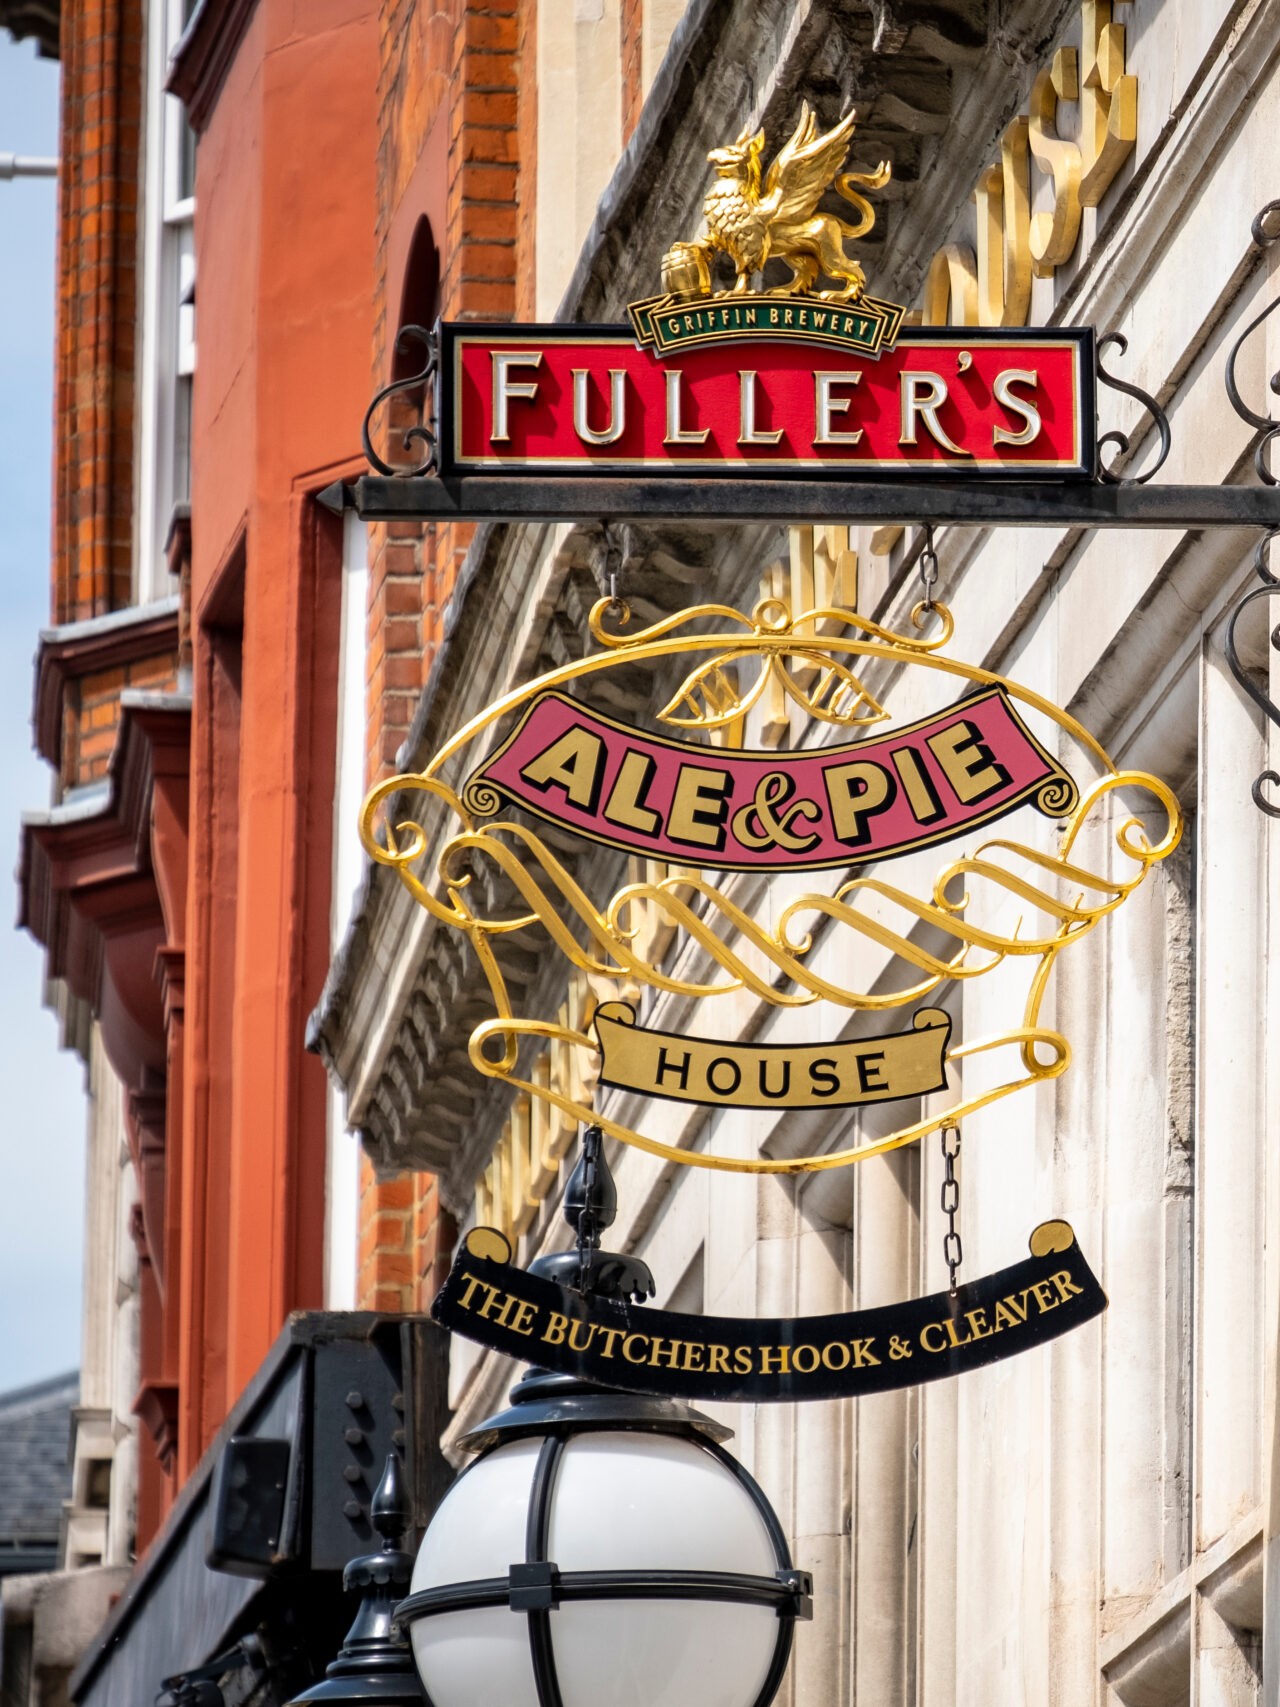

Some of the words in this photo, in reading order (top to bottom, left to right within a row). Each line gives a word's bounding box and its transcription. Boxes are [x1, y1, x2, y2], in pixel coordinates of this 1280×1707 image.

[668, 308, 756, 335] GRIFFIN
[769, 308, 870, 337] BREWERY
[489, 350, 1042, 455] FULLER'S
[655, 1047, 889, 1099] HOUSE
[459, 1271, 539, 1336] THE
[541, 1311, 753, 1375] BUTCHERS
[757, 1336, 881, 1375] HOOK
[888, 1336, 913, 1361] &
[918, 1270, 1084, 1354] CLEAVER
